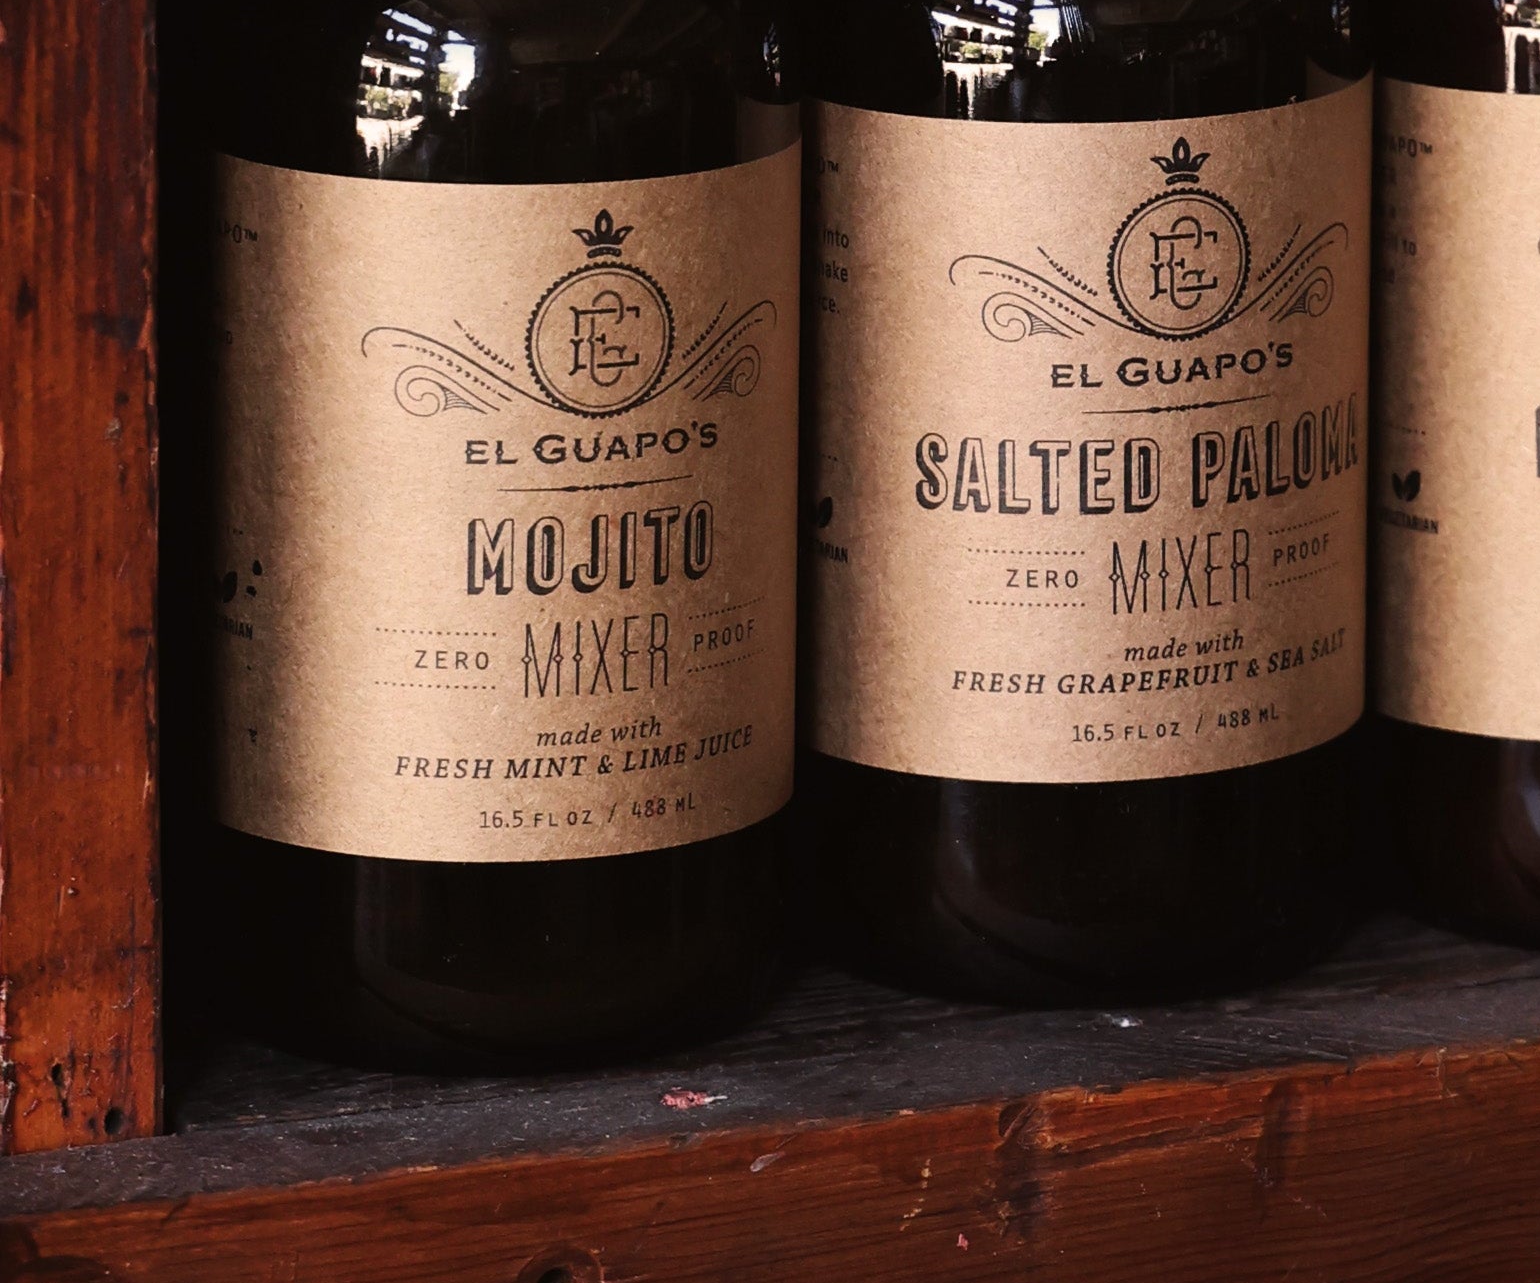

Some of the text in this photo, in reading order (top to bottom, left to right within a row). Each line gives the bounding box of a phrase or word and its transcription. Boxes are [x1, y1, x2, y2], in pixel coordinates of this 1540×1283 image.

[1051, 342, 1294, 389] EL GUAPO'S
[465, 421, 719, 466] EL GUAPO'S
[915, 391, 1359, 516] SALTED PALOMA
[466, 500, 716, 596] MOJITO
[1006, 528, 1331, 615] ZERO MIXER PROOF
[414, 612, 755, 698] ZERO MIXER PROOF
[953, 628, 1347, 696] FRESH GRAPEFRUIT & SEA SALT
[1124, 630, 1245, 663] made with
[536, 715, 662, 748] made with
[1072, 705, 1280, 743] 16.5 FL OZ / 488 ML
[395, 724, 754, 780] FRESH MINT & LIME JUICE
[479, 793, 697, 830] 16.5 FL OZ / 488 ML
